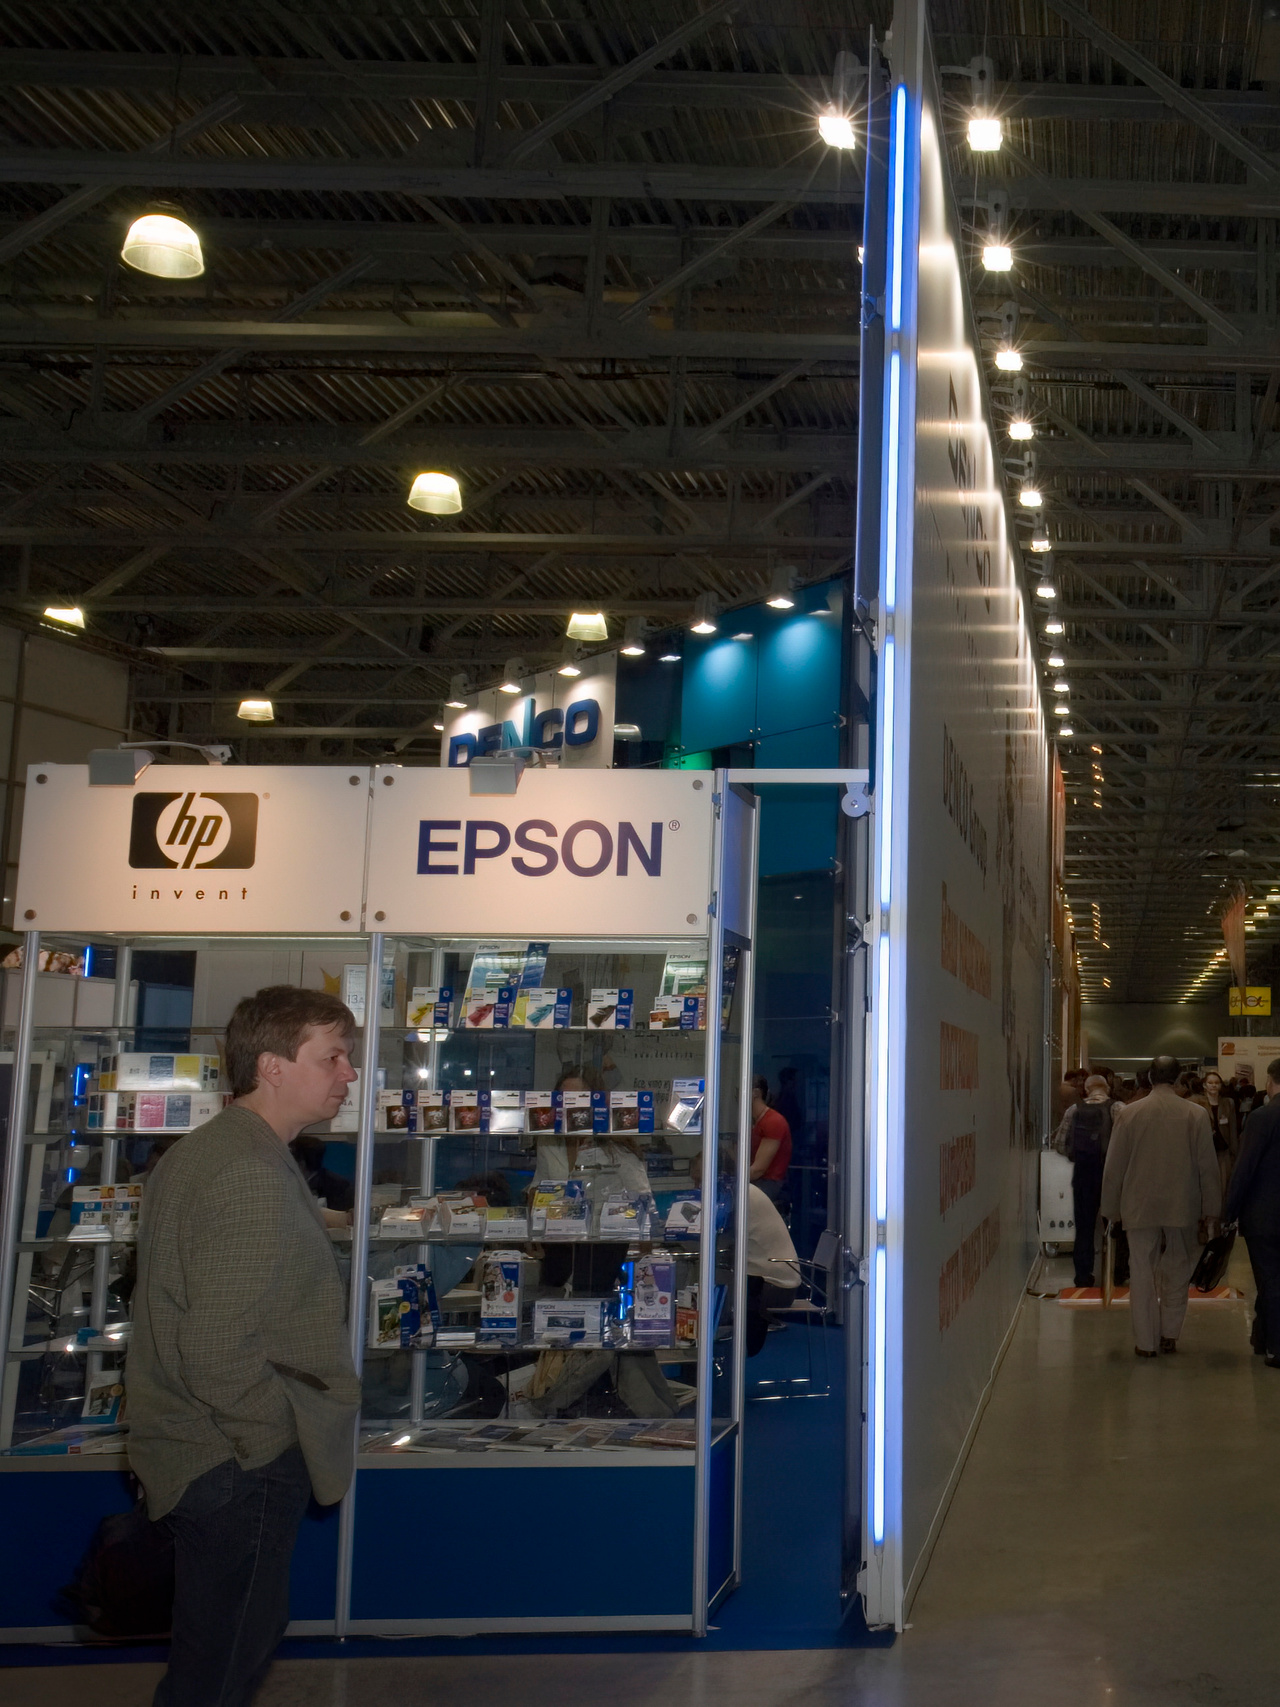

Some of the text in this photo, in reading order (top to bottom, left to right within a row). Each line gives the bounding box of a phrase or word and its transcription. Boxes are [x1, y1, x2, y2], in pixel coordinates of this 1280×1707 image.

[449, 698, 601, 767] DENCO
[416, 819, 664, 877] EPSON
[132, 885, 250, 901] invent
